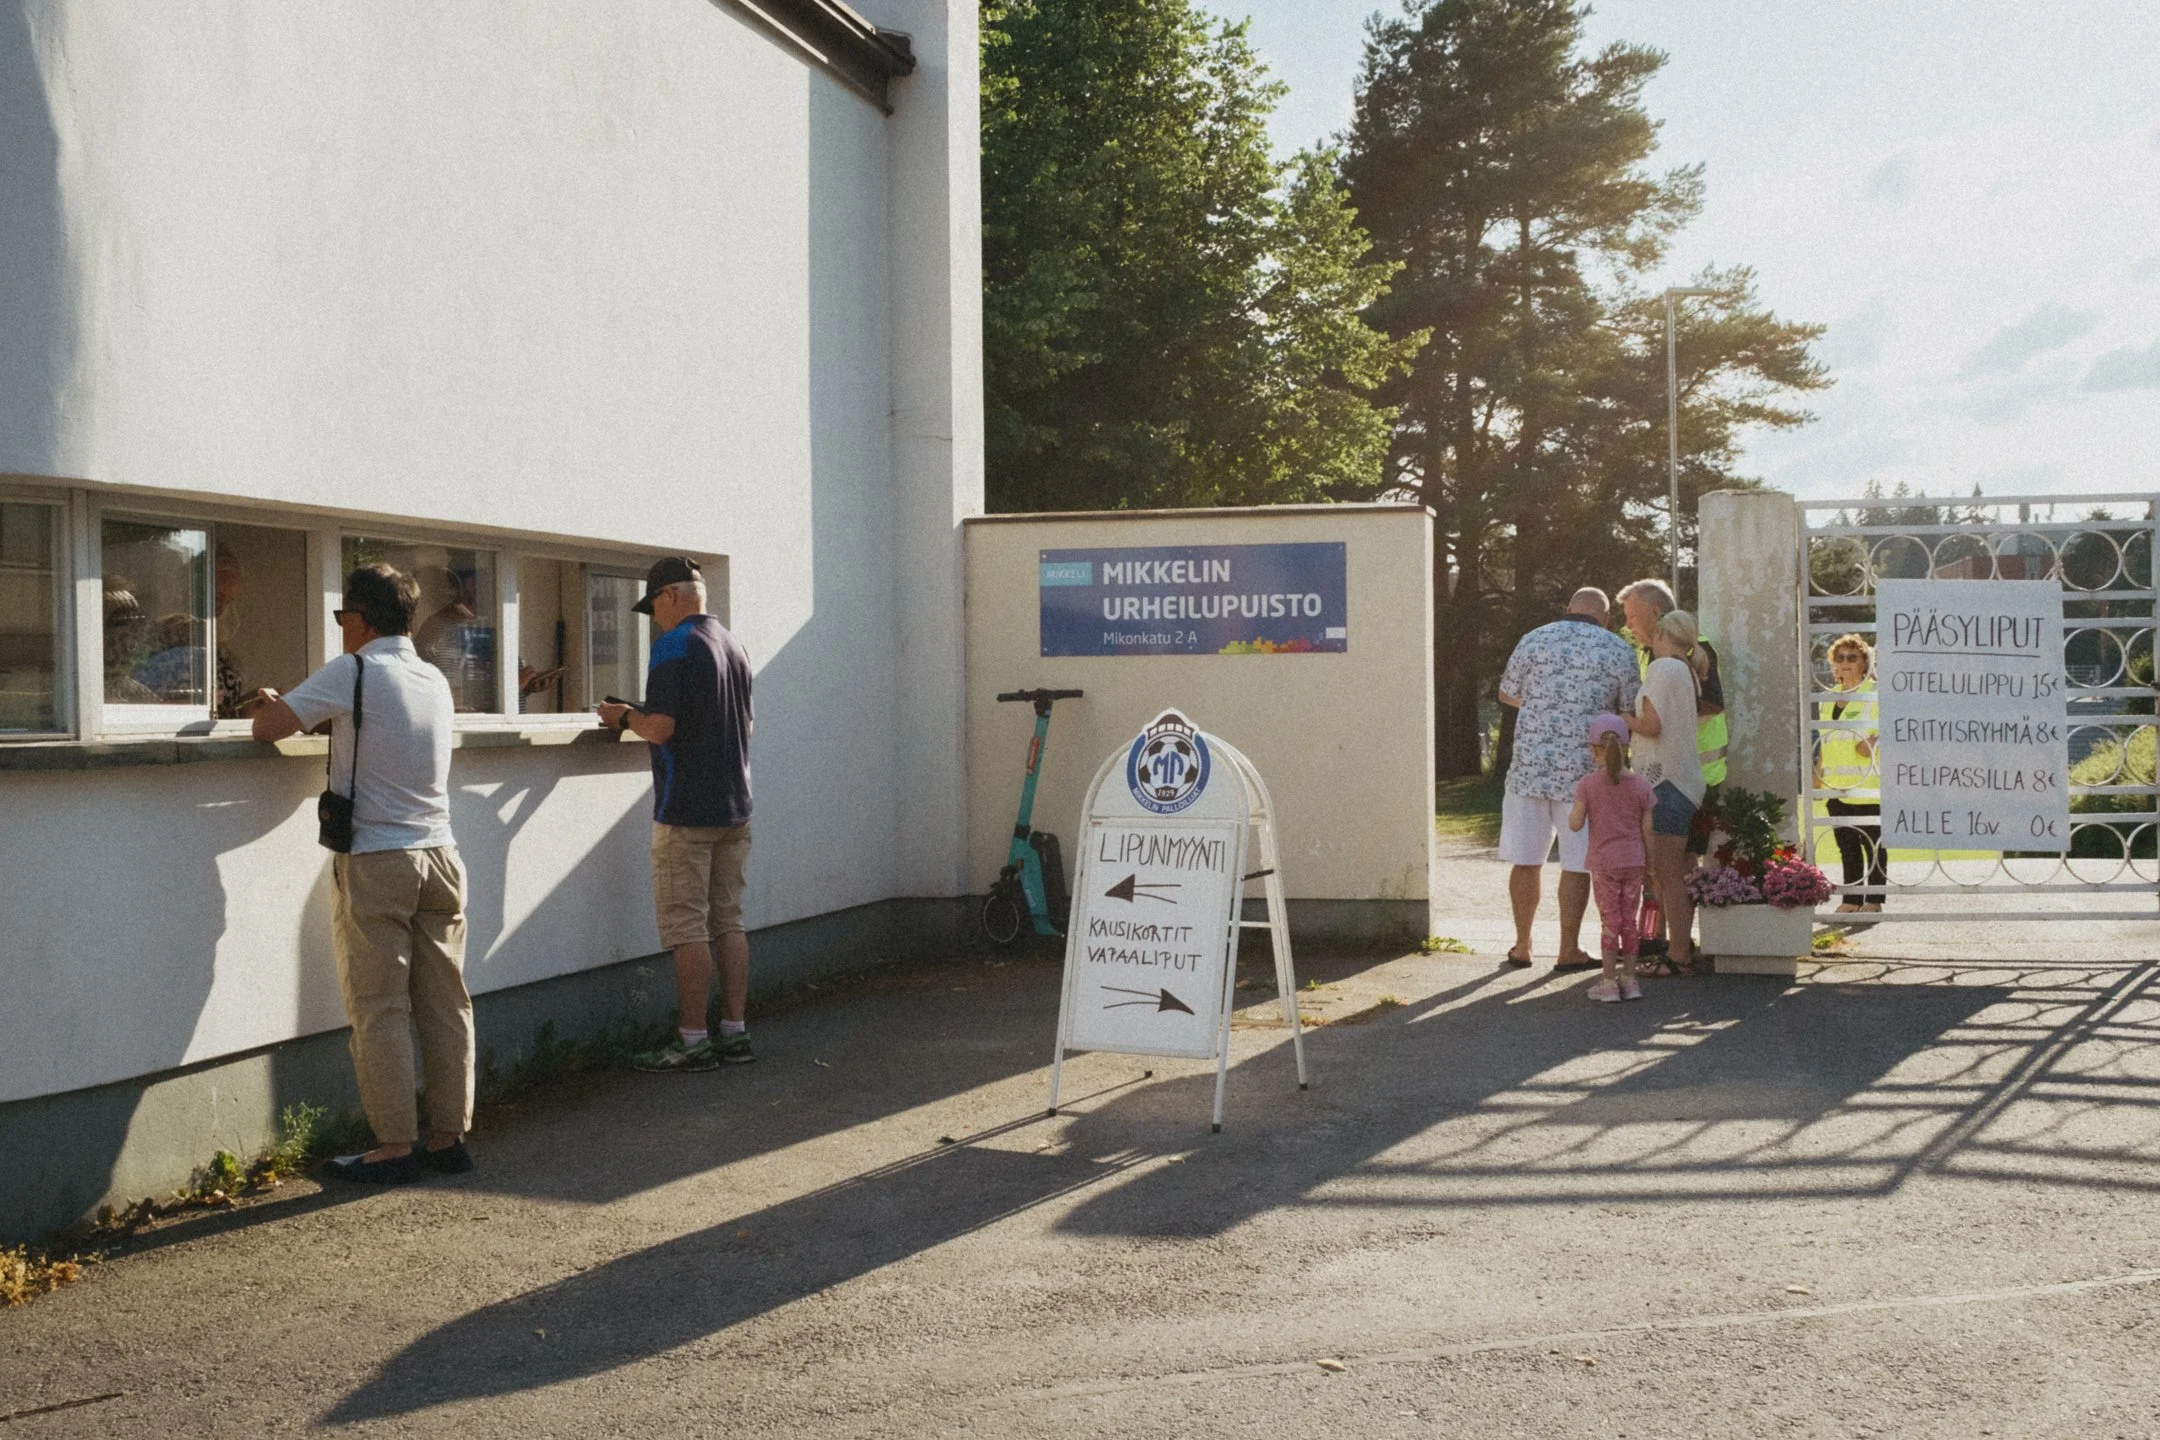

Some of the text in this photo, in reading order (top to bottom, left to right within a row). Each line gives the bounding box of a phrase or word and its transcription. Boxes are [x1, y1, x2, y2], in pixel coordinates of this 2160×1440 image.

[1103, 559, 1231, 585] MIKKELIN
[1103, 593, 1322, 620] URHEILUPUISTO
[1103, 630, 1198, 645] Mikonkatu 2 A
[1893, 607, 2045, 649] PÄÄSYLIPUT
[1891, 670, 2059, 700] OTTELULIPPU 15€
[1894, 715, 2060, 745] ERITYISRYHMÄ 8€
[1896, 763, 2056, 793] PELIPASSILLA 8€
[1132, 787, 1159, 811] MIKKELIN
[1157, 789, 1175, 798] 1929
[1894, 809, 1954, 836] ALLE
[2030, 814, 2057, 838] 0€
[1099, 833, 1227, 873] LIPUNMYYNTI
[1088, 916, 1194, 944] KAUSIKORTIT
[1088, 946, 1203, 972] VAPAALIPUT
